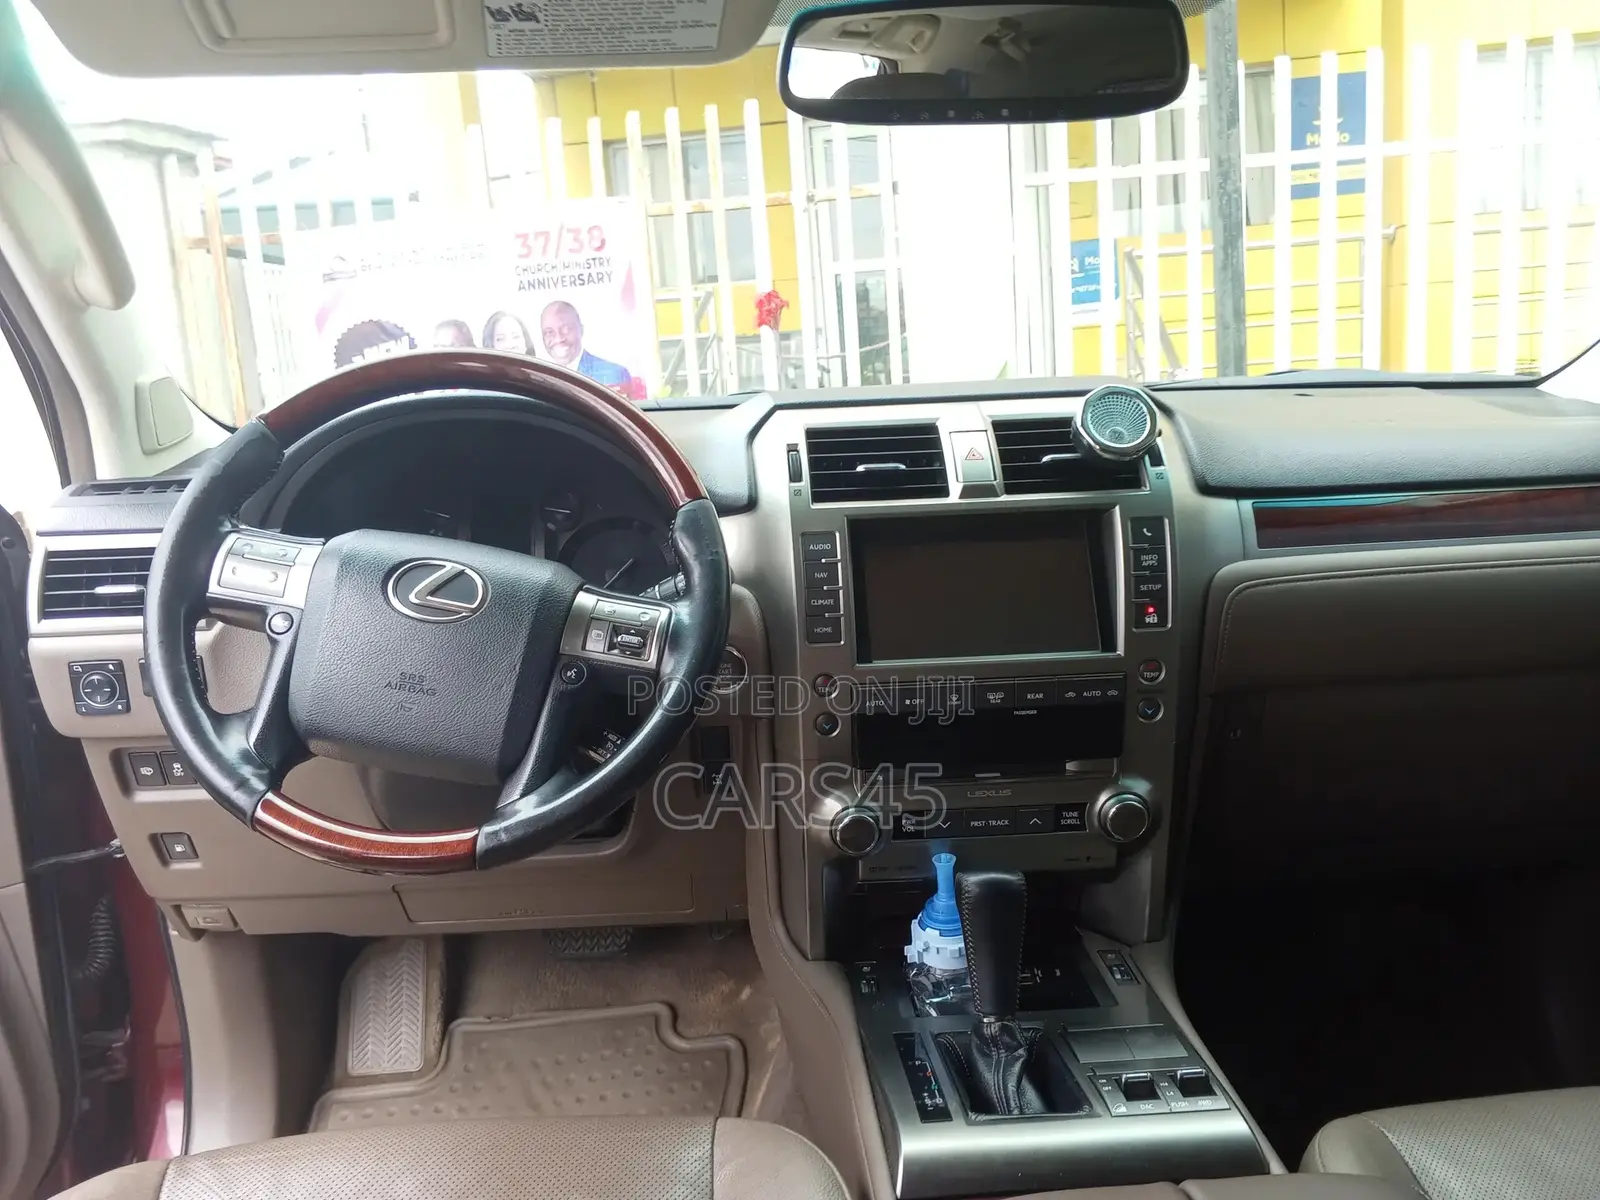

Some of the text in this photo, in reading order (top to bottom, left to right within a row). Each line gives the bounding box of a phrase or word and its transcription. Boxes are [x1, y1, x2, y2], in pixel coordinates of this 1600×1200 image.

[514, 222, 606, 259] 37/38
[518, 271, 613, 292] ANNIVERSARY
[400, 671, 426, 683] SRS
[384, 681, 437, 696] AIRBAG
[967, 789, 1012, 798] LEXUS
